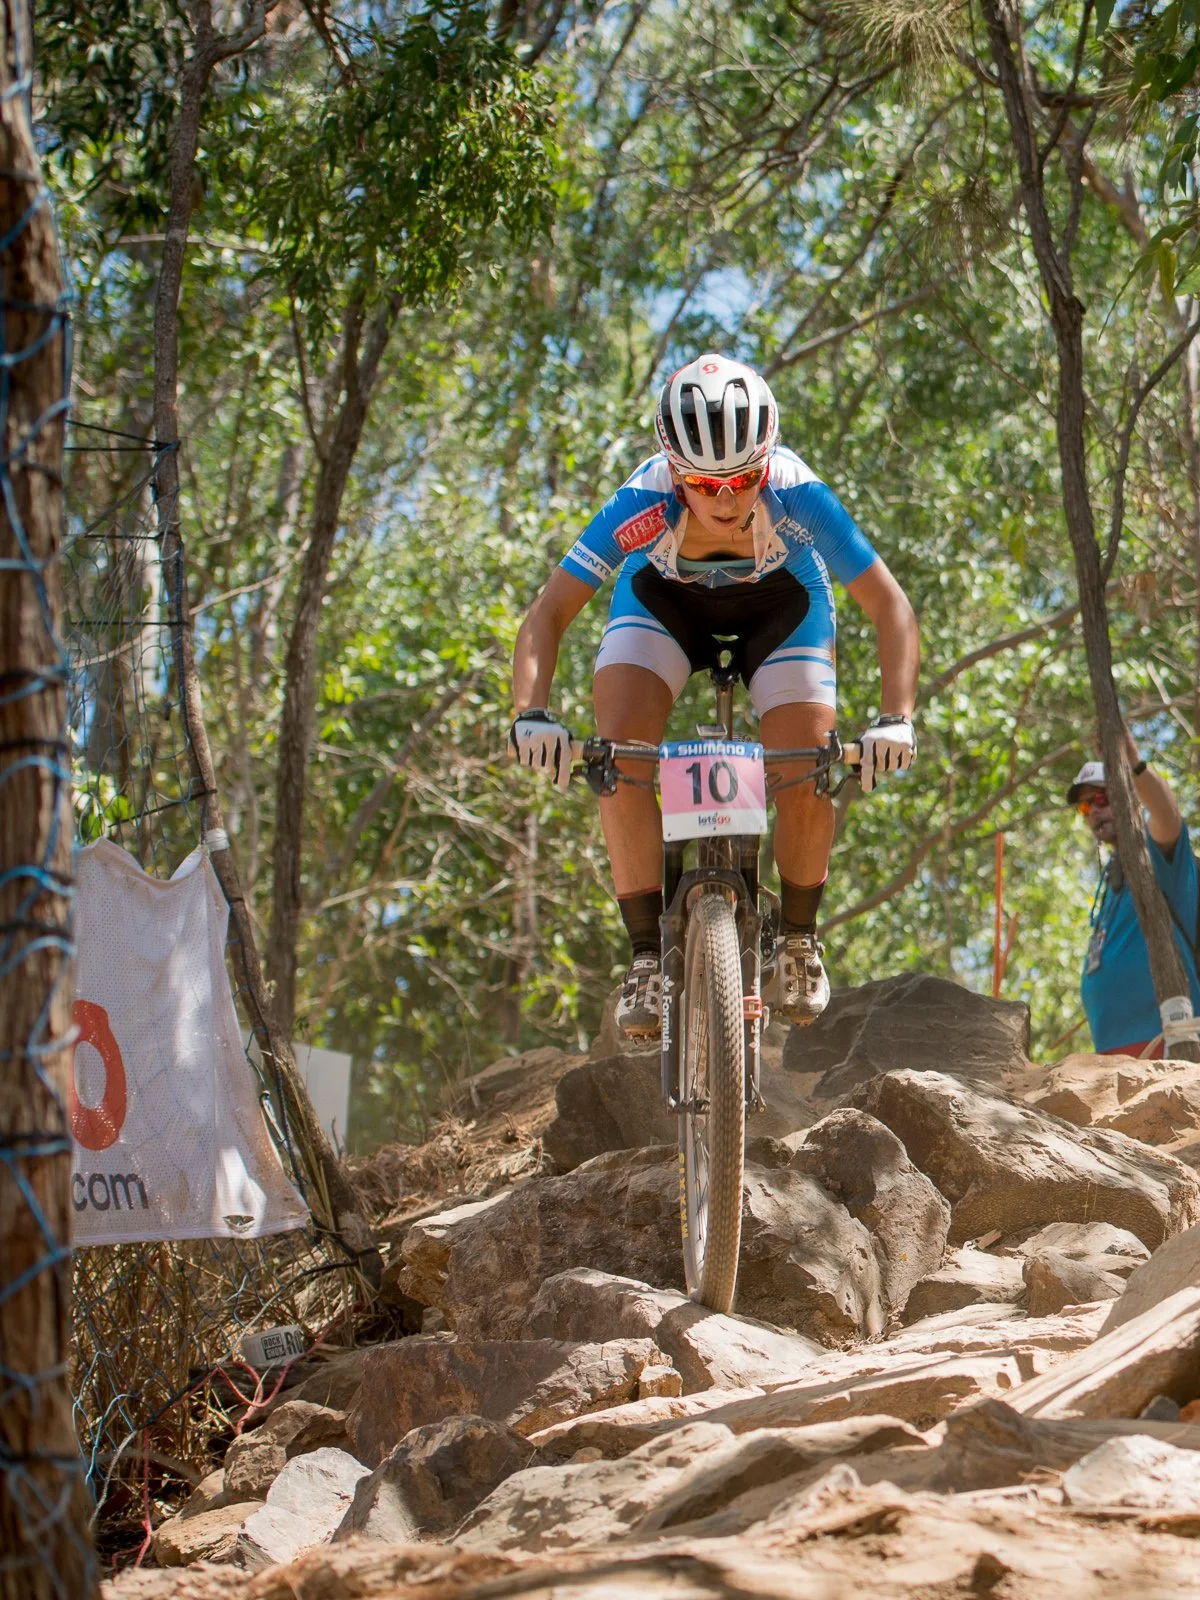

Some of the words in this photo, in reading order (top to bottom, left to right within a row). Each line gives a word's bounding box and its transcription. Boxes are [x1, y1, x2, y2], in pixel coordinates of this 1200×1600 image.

[678, 743, 745, 756] SHIMANO
[685, 760, 738, 806] 10
[698, 812, 731, 826] letsgo
[787, 939, 812, 950] SIDI
[633, 959, 658, 971] SIDI
[661, 994, 673, 1053] Formula
[264, 1336, 281, 1347] ROCK
